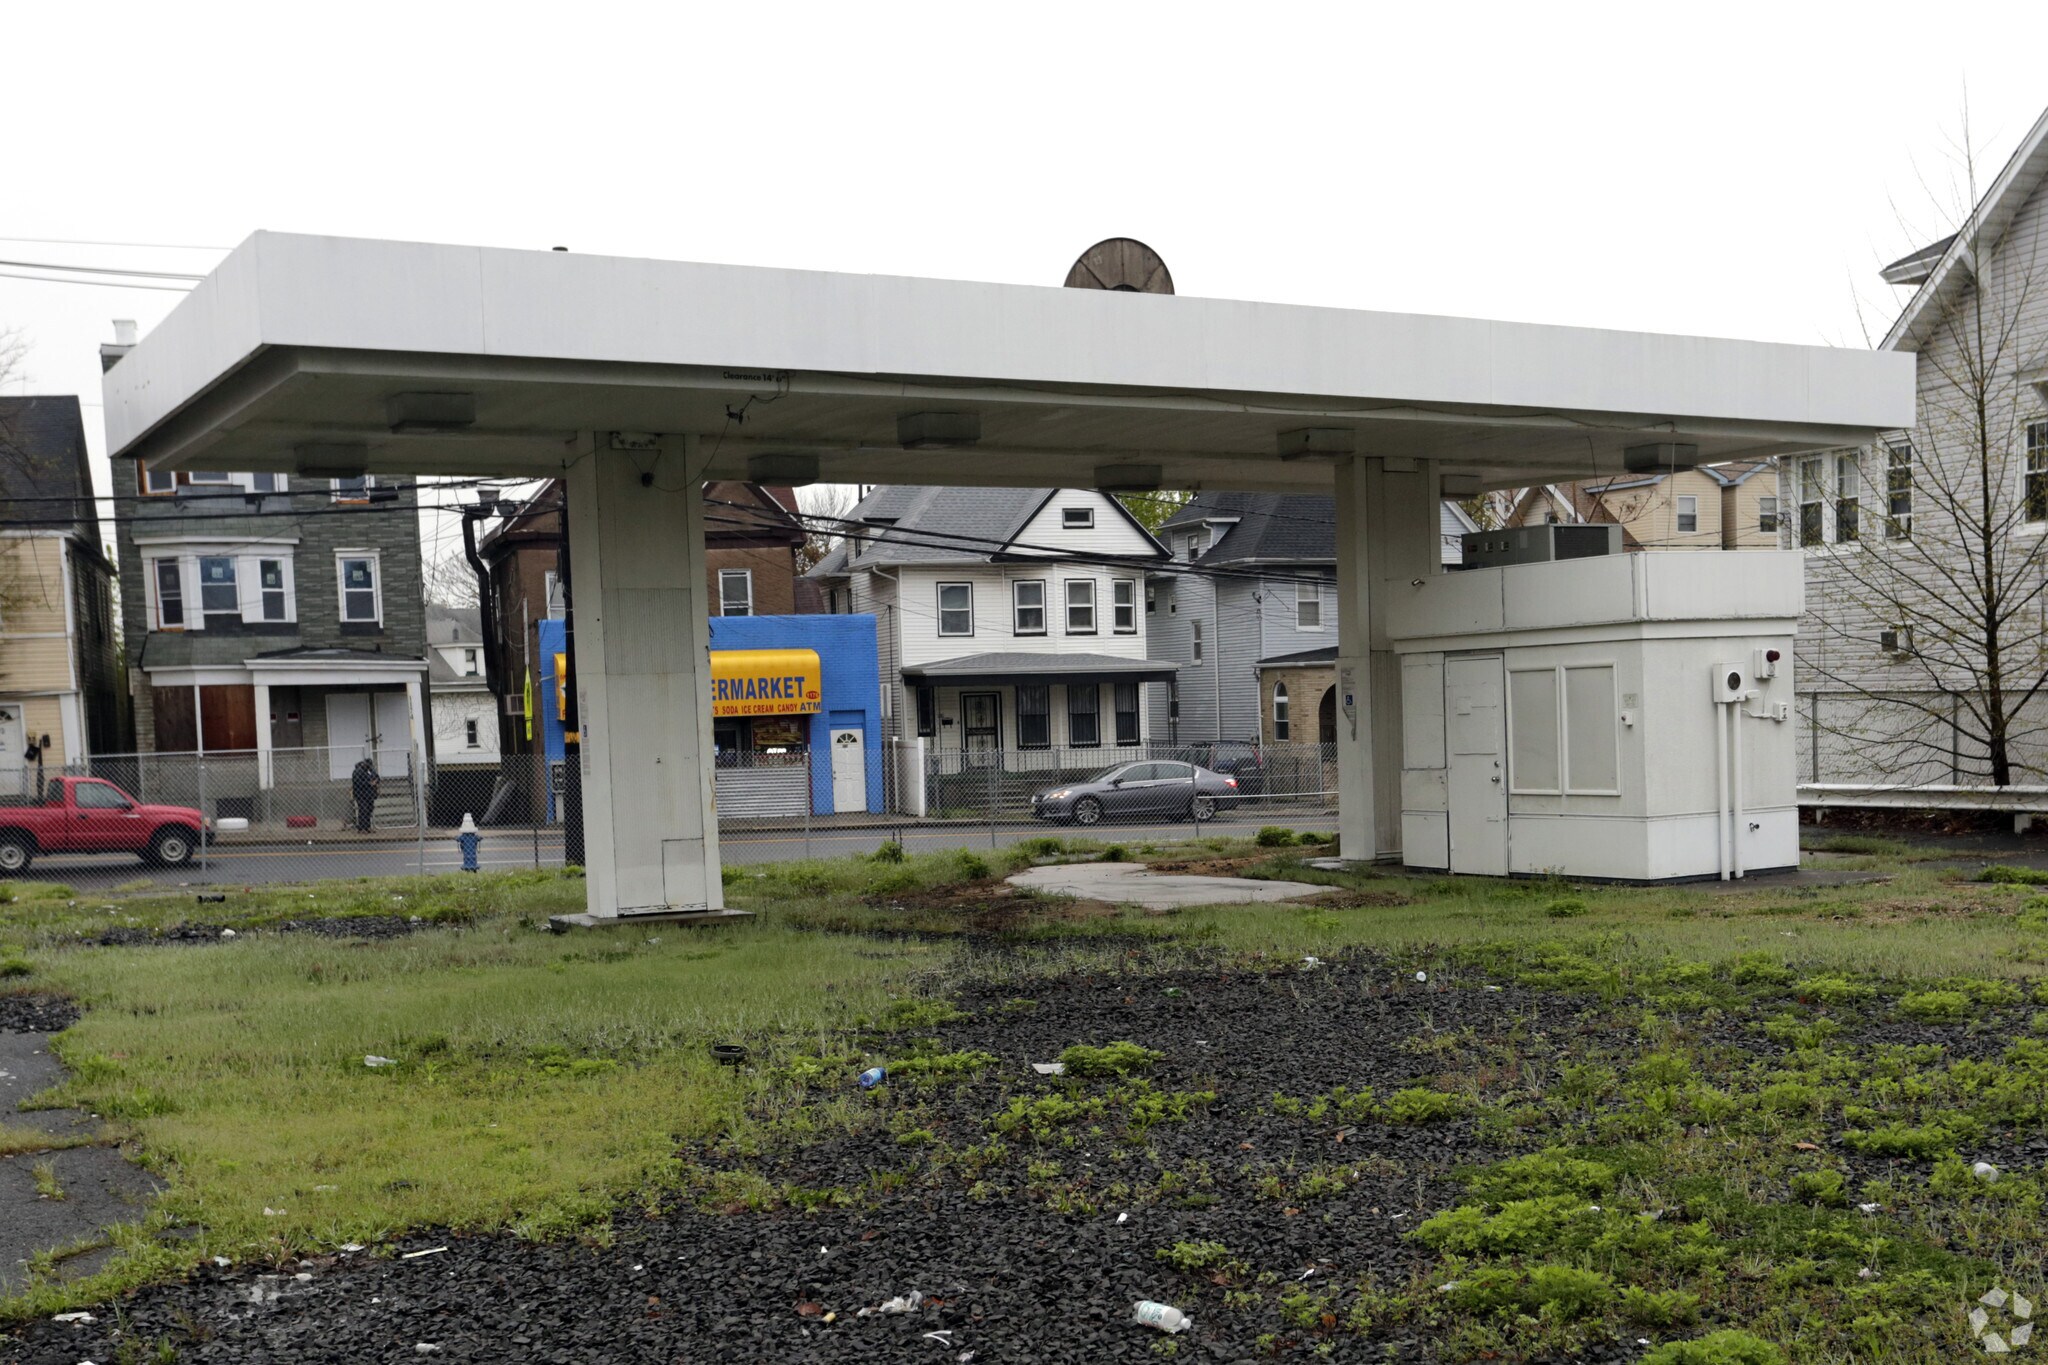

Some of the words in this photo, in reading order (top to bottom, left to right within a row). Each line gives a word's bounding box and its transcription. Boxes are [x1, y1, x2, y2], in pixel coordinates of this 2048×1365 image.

[723, 371, 761, 381] Clearance
[722, 705, 738, 715] SODA
[741, 705, 751, 714] ICE
[753, 704, 774, 714] CREAM
[778, 703, 798, 712] CANDY
[800, 702, 821, 711] ATM
